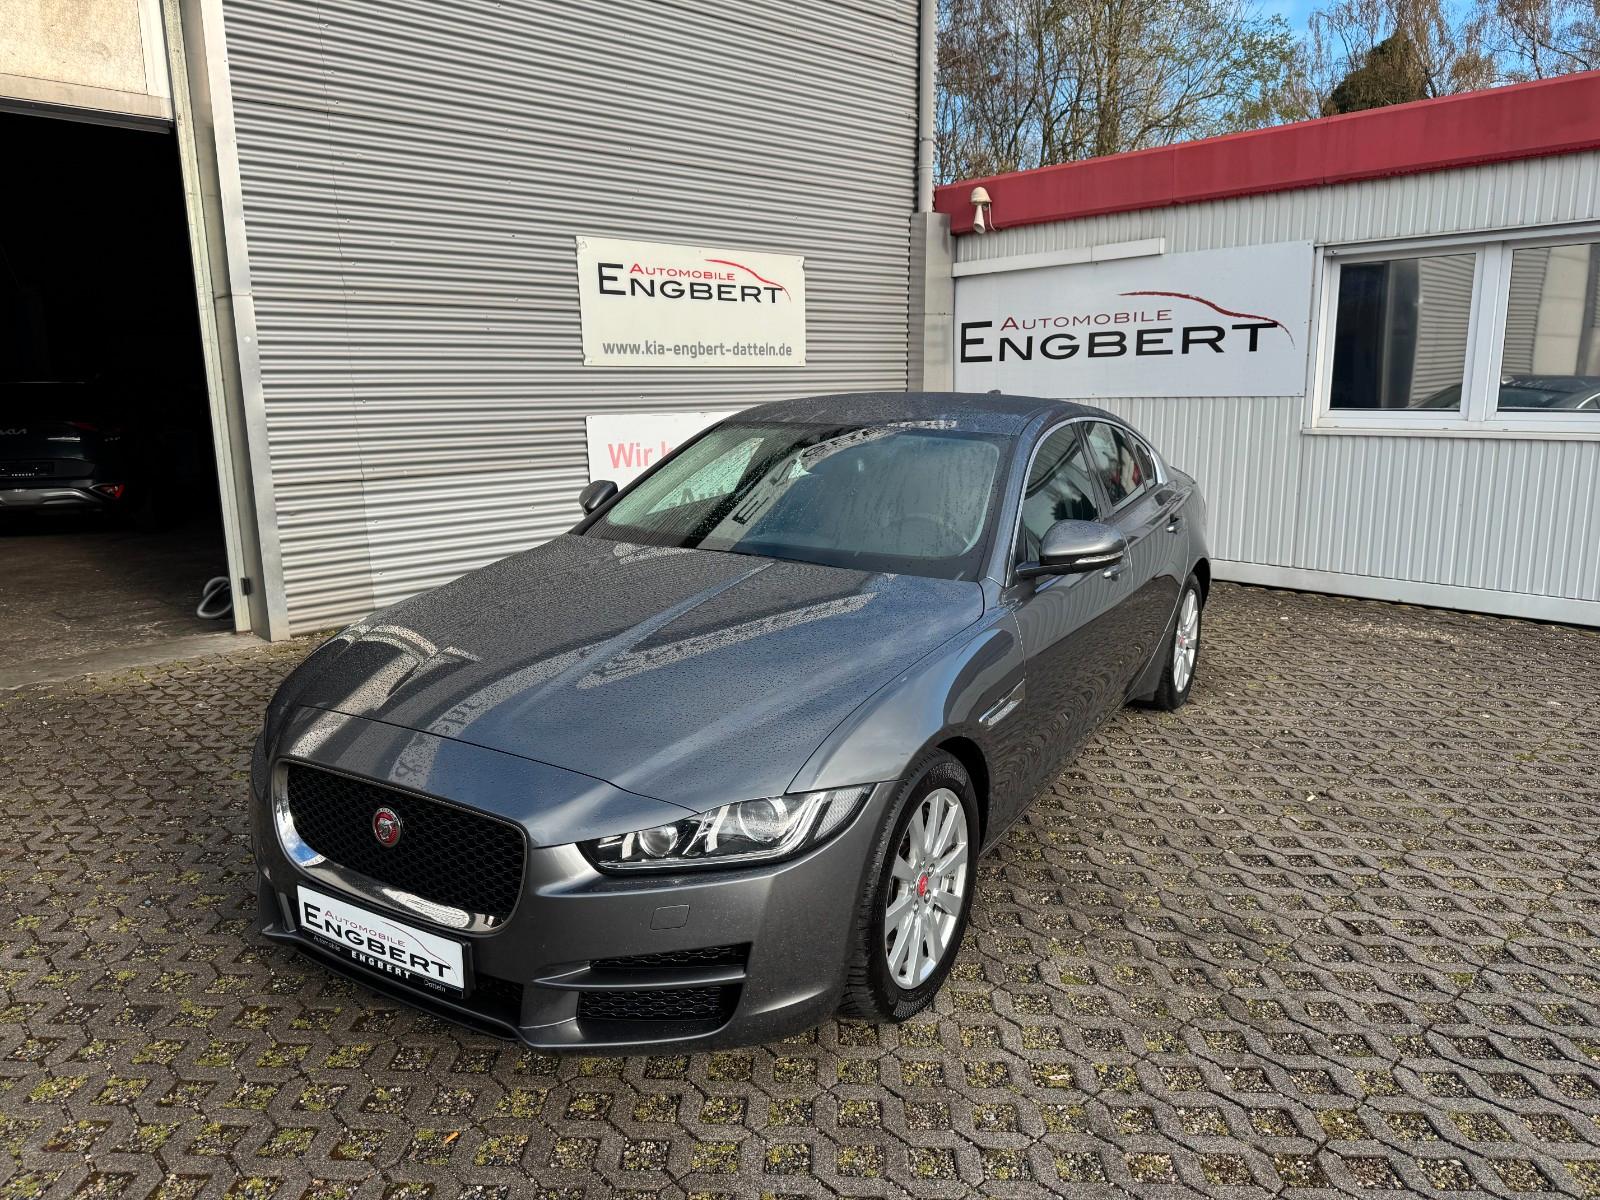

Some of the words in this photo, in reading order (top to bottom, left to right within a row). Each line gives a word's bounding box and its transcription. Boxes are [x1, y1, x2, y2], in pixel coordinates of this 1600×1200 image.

[598, 262, 784, 304] ENGBERT
[629, 263, 735, 281] AUTOMOBILE
[1001, 310, 1172, 331] AUTOMOBILE
[602, 340, 792, 358] www.kia-engbert-datteln.de
[961, 321, 1278, 363] ENGBERT
[608, 442, 654, 469] Wir
[304, 902, 451, 977] ENGBERT
[324, 910, 405, 947] AUTOMOBILE
[351, 950, 411, 979] ENGBERT
